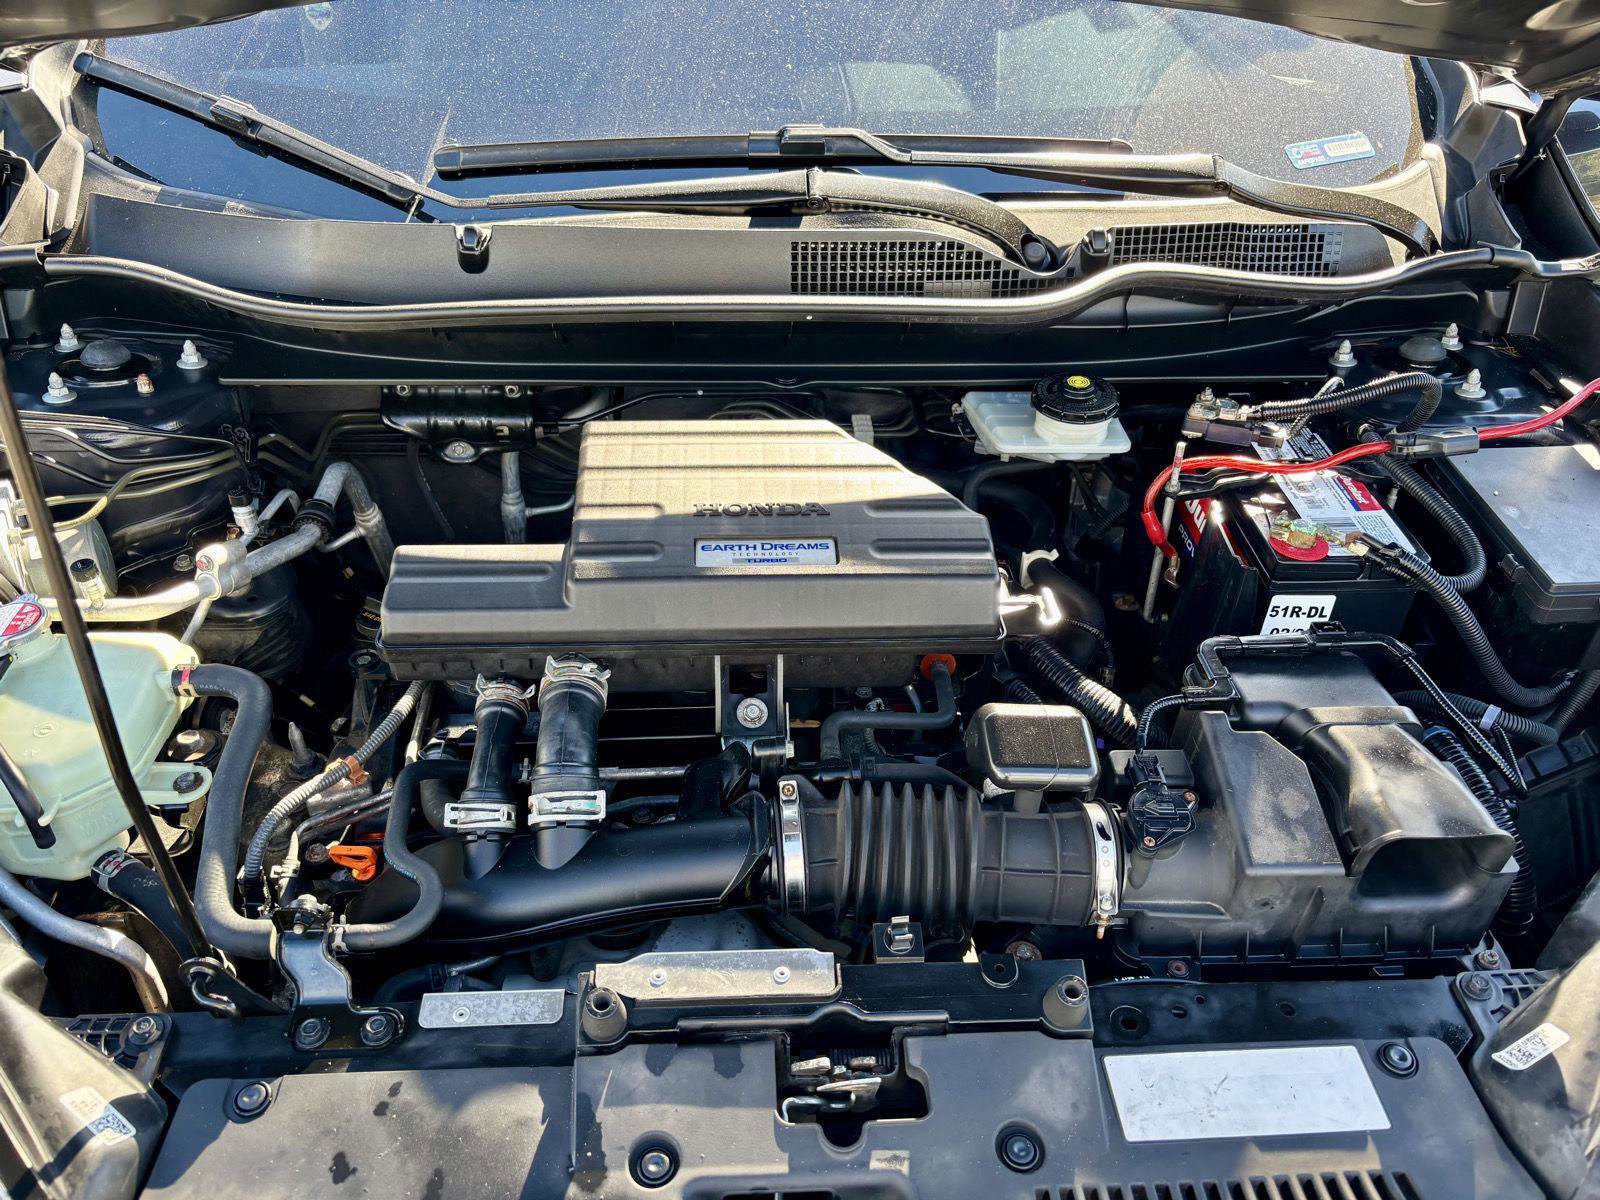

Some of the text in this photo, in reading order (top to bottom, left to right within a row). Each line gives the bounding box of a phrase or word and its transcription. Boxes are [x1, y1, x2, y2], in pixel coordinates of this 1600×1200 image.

[693, 502, 831, 517] HONDA
[761, 542, 829, 551] DREAMS
[1269, 605, 1328, 619] 51R-DL
